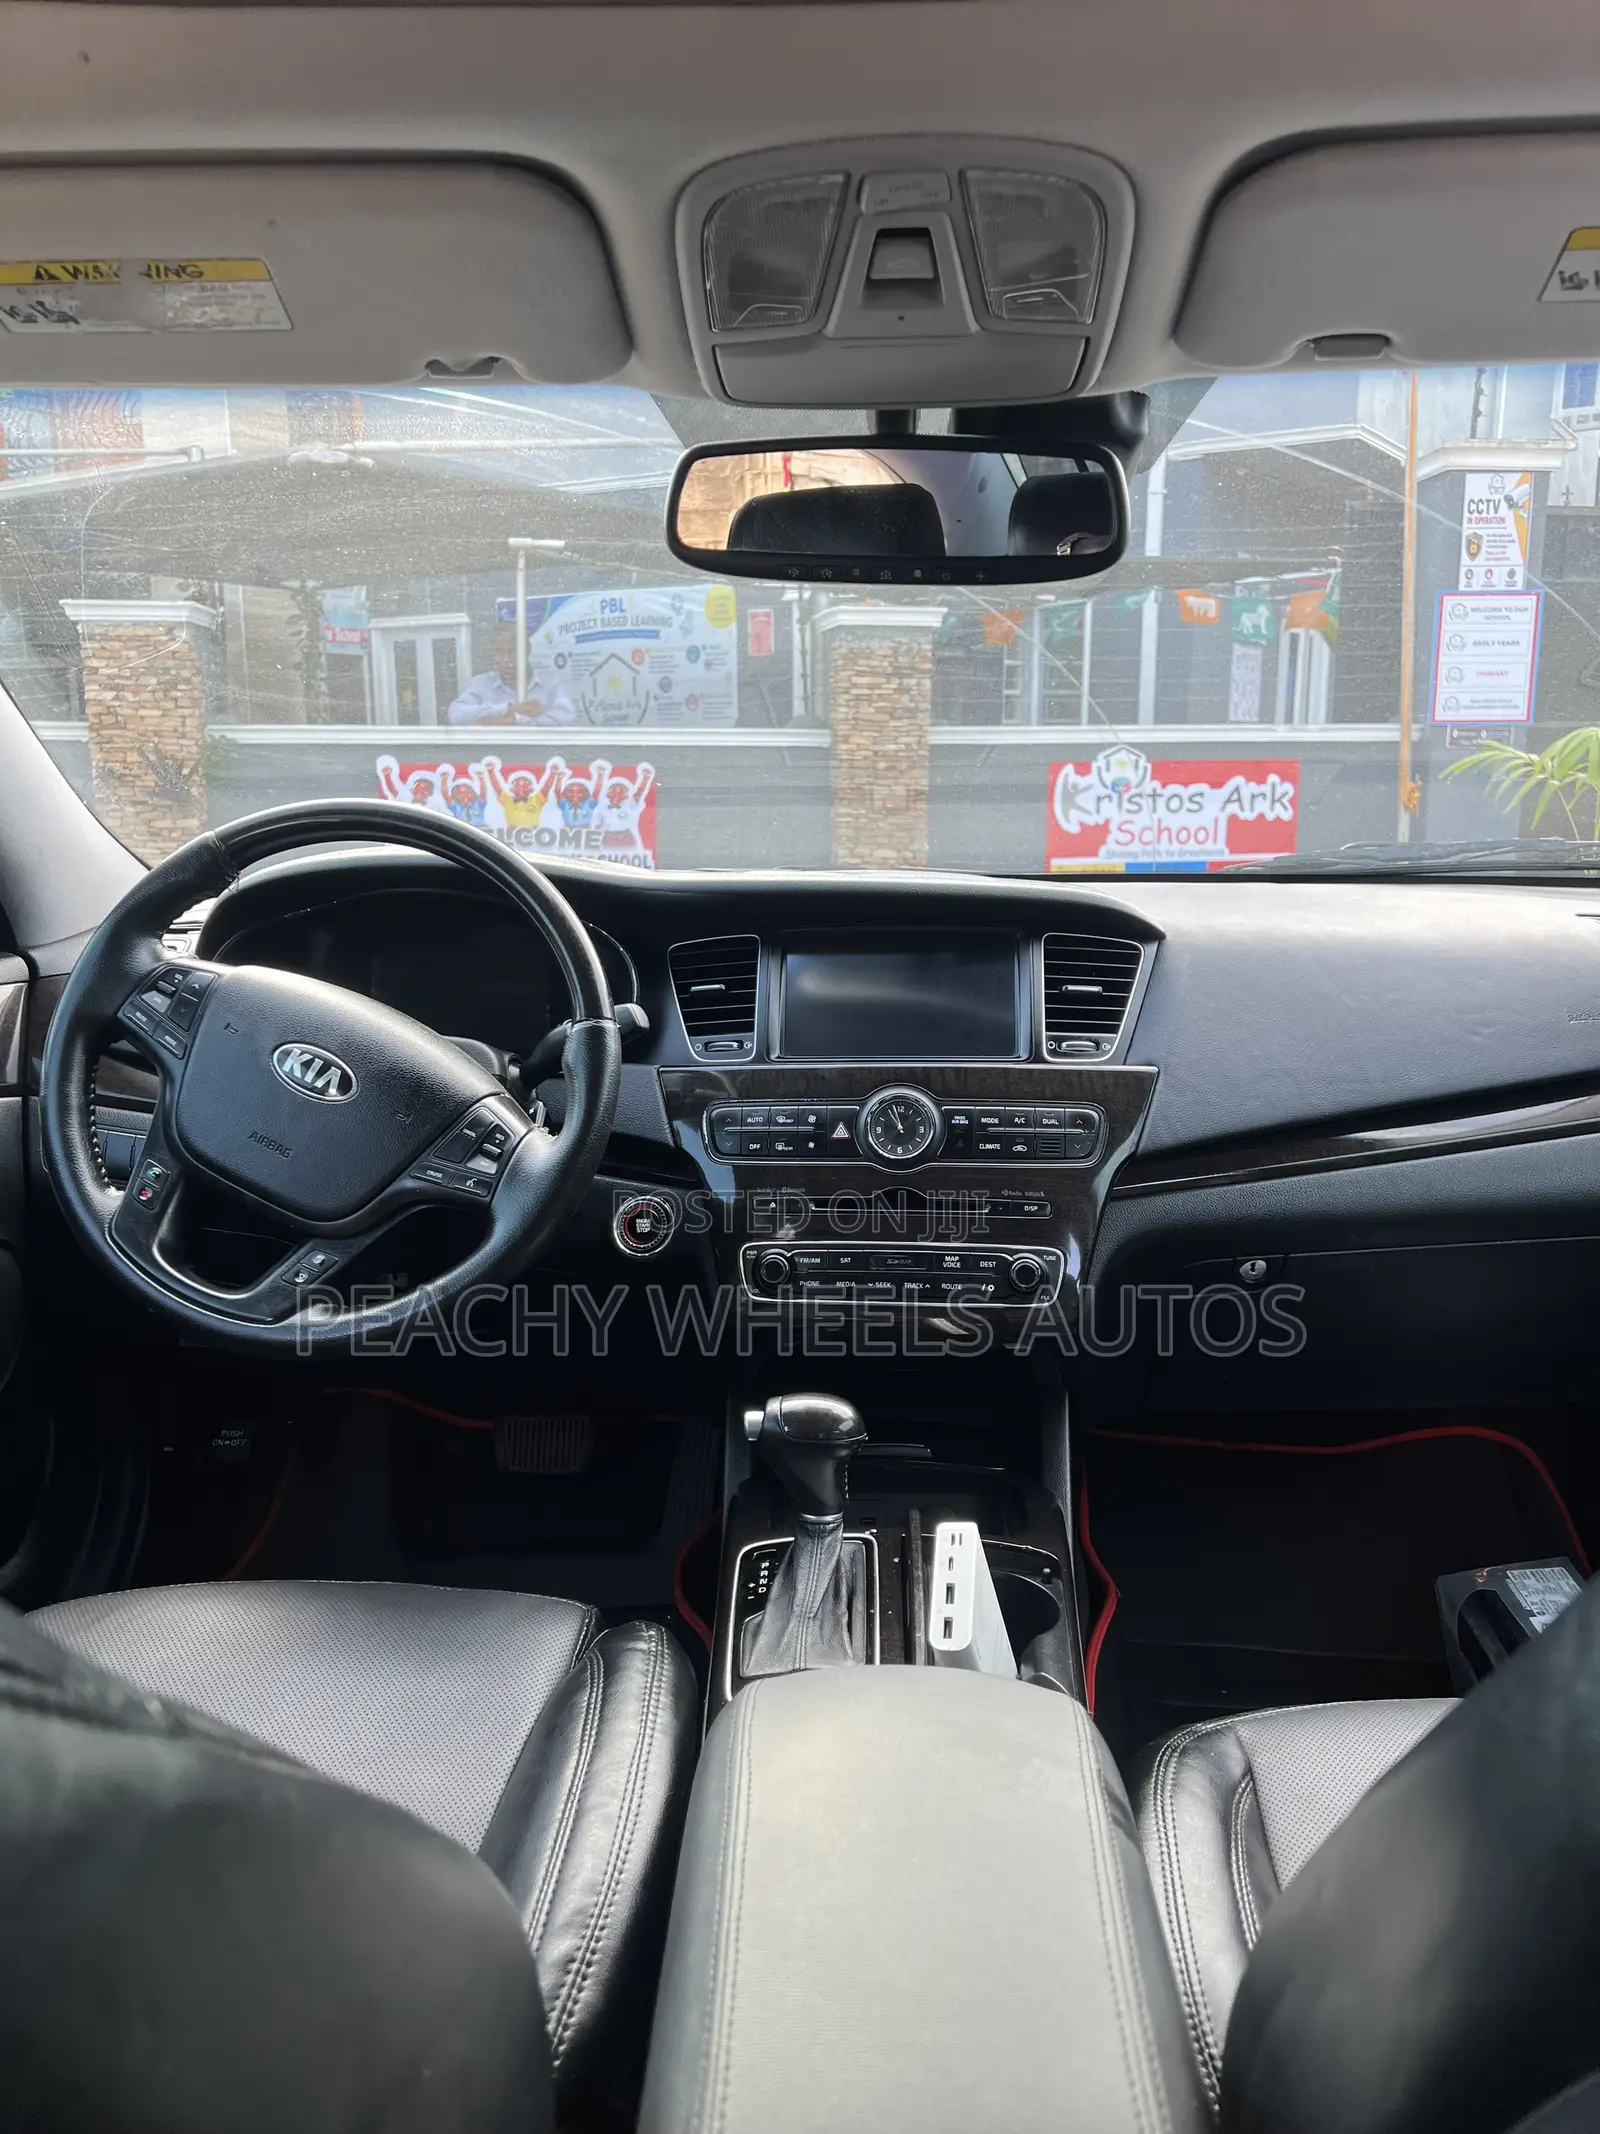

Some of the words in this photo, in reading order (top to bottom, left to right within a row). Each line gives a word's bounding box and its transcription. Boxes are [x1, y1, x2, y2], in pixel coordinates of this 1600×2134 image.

[1467, 498, 1502, 515] CCTV
[1474, 516, 1507, 525] OPERATION
[600, 598, 626, 615] PBL
[600, 615, 629, 629] BASED
[631, 614, 674, 629] LEARNING
[1221, 781, 1291, 814] Ark
[1115, 817, 1219, 847] School
[281, 1047, 343, 1096] KIA
[747, 1116, 764, 1124] AUTO
[981, 1117, 999, 1125] MODE
[1014, 1117, 1026, 1125] A/C
[1042, 1118, 1059, 1126] DUAL
[247, 1130, 293, 1160] AIRBAG
[979, 1143, 1001, 1151] CLIMATE
[942, 1261, 962, 1269] VOICE
